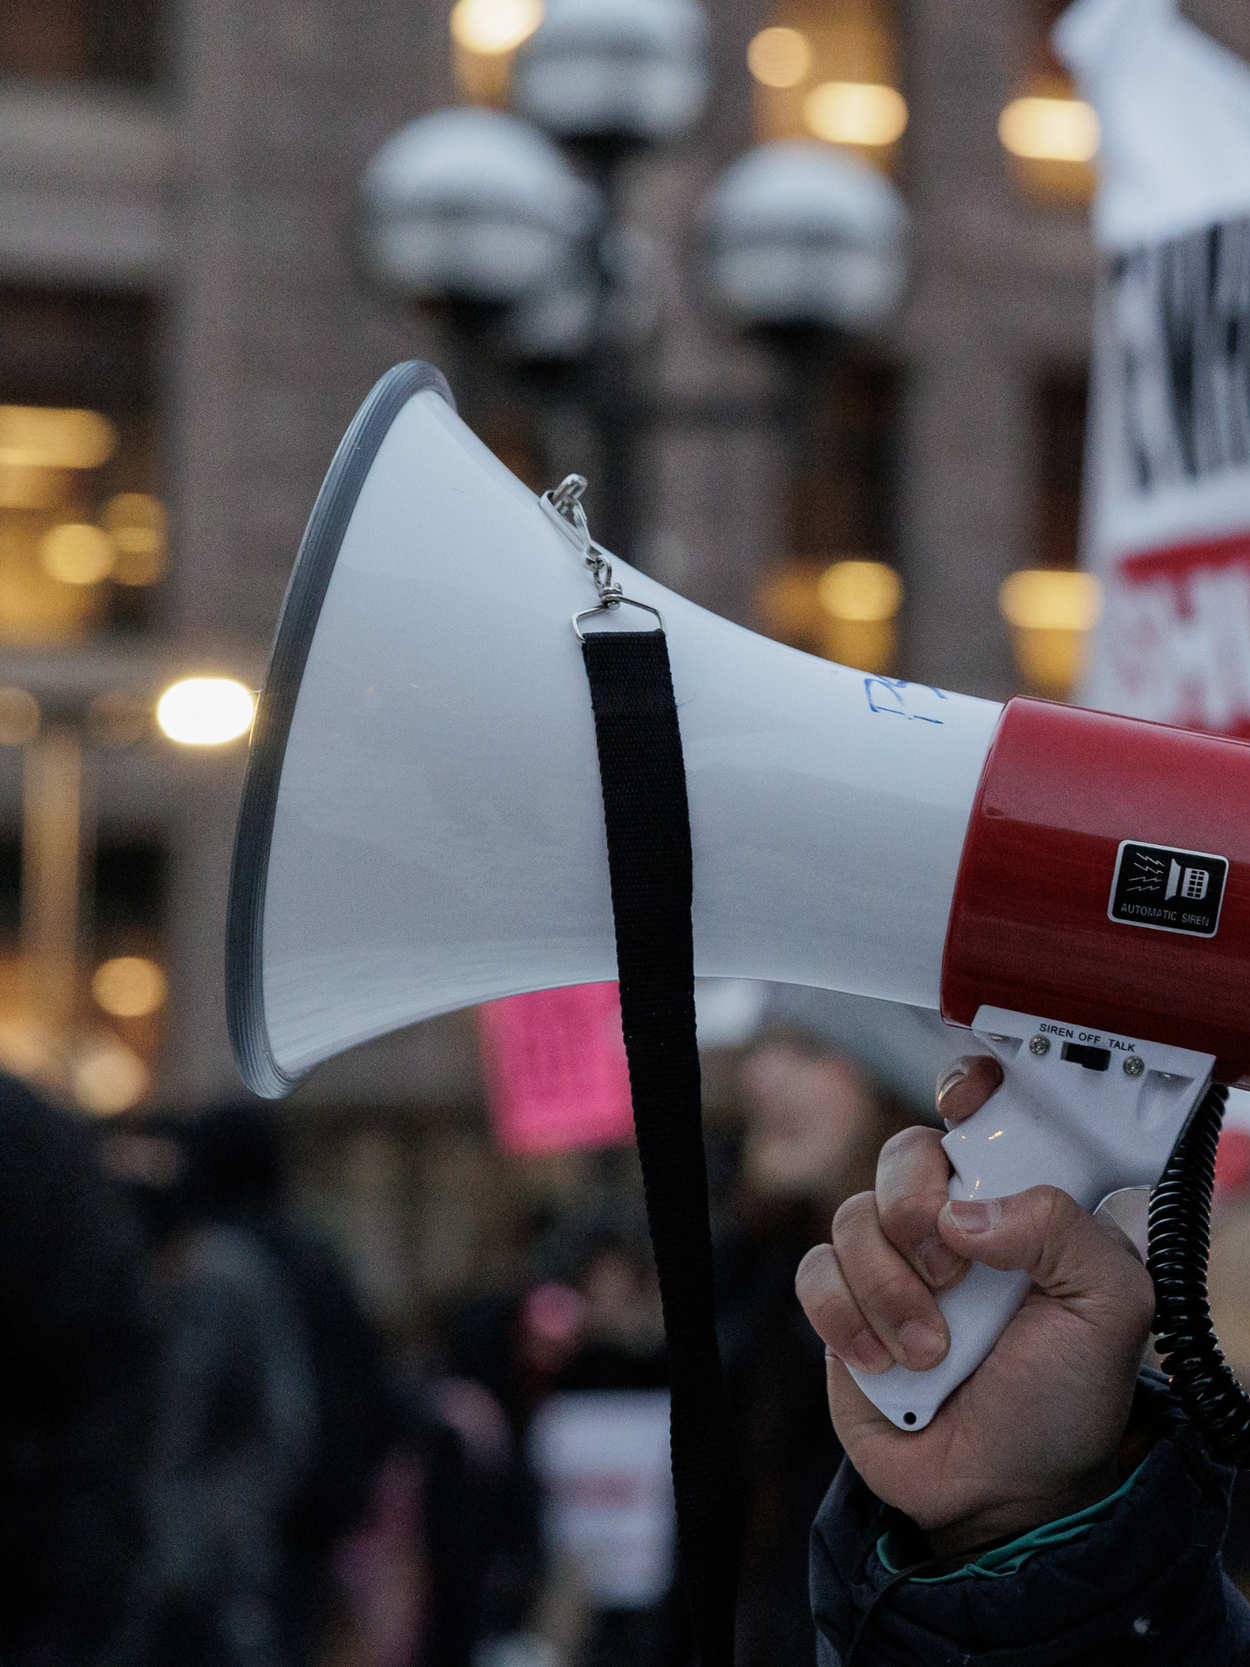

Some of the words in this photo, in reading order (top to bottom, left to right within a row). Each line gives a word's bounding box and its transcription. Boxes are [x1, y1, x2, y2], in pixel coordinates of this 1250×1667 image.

[1121, 903, 1178, 921] AUTOMATIC
[1181, 913, 1210, 927] SIREN
[1039, 1023, 1074, 1039] SIREN
[1078, 1032, 1101, 1045] OFF
[1109, 1038, 1136, 1052] TALK
